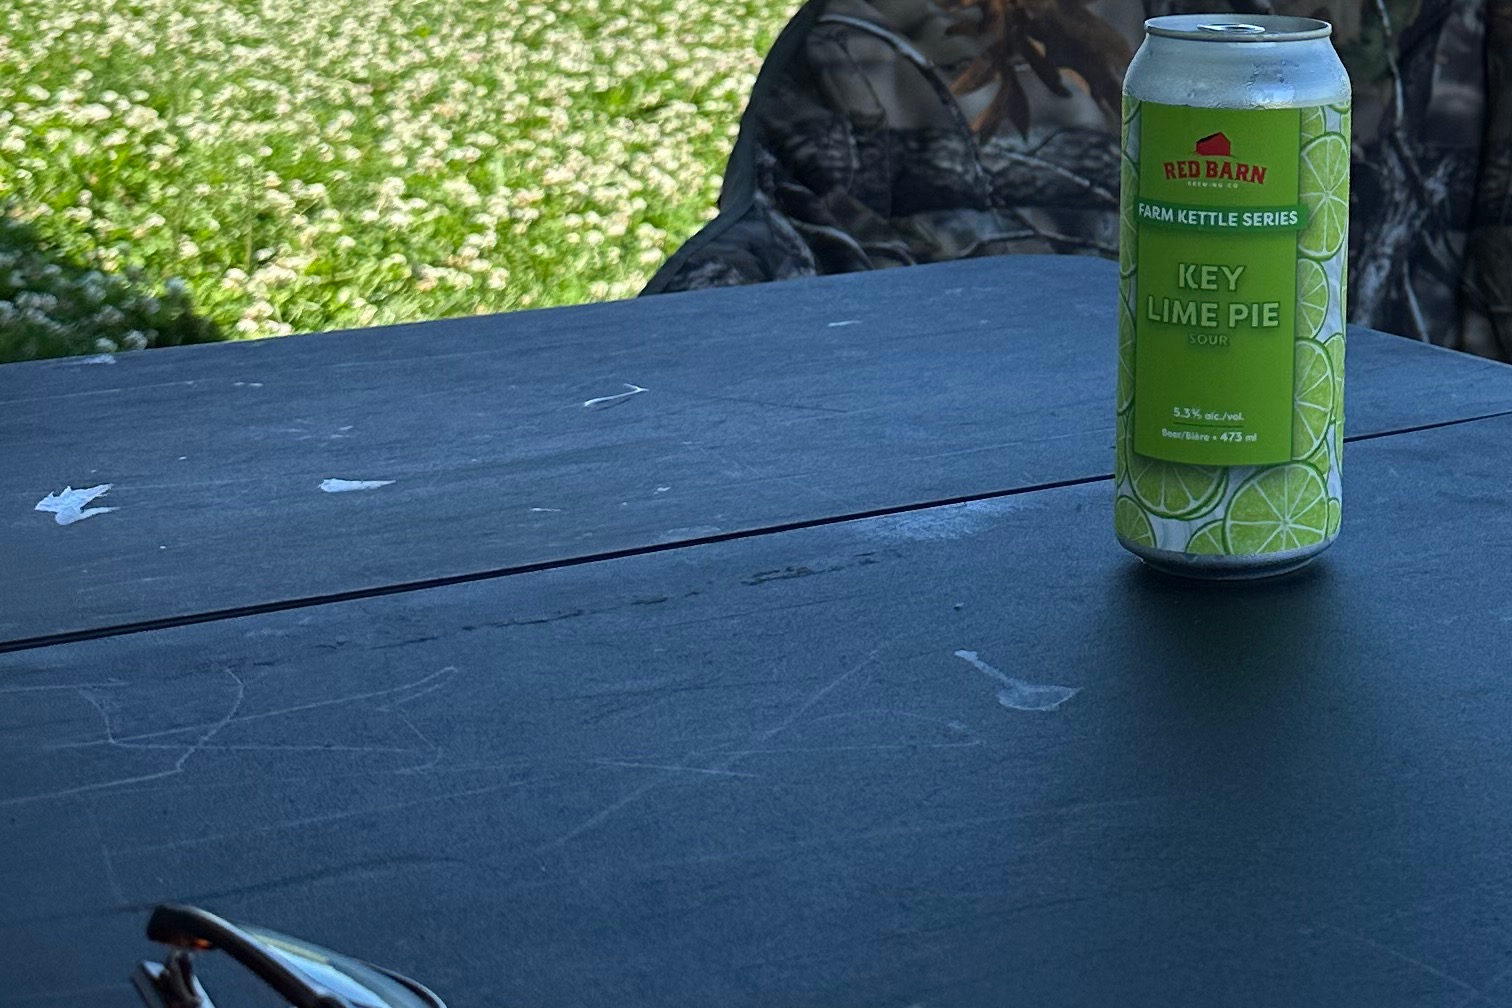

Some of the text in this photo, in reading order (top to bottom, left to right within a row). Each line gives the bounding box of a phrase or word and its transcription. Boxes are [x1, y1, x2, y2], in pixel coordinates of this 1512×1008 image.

[1163, 160, 1268, 185] RED BARN
[1138, 202, 1298, 227] FARM KETTLE SERIES
[1178, 263, 1245, 291] KEY
[1147, 294, 1279, 328] LIME PIE
[1188, 332, 1229, 345] SOUR
[1219, 431, 1243, 442] 473
